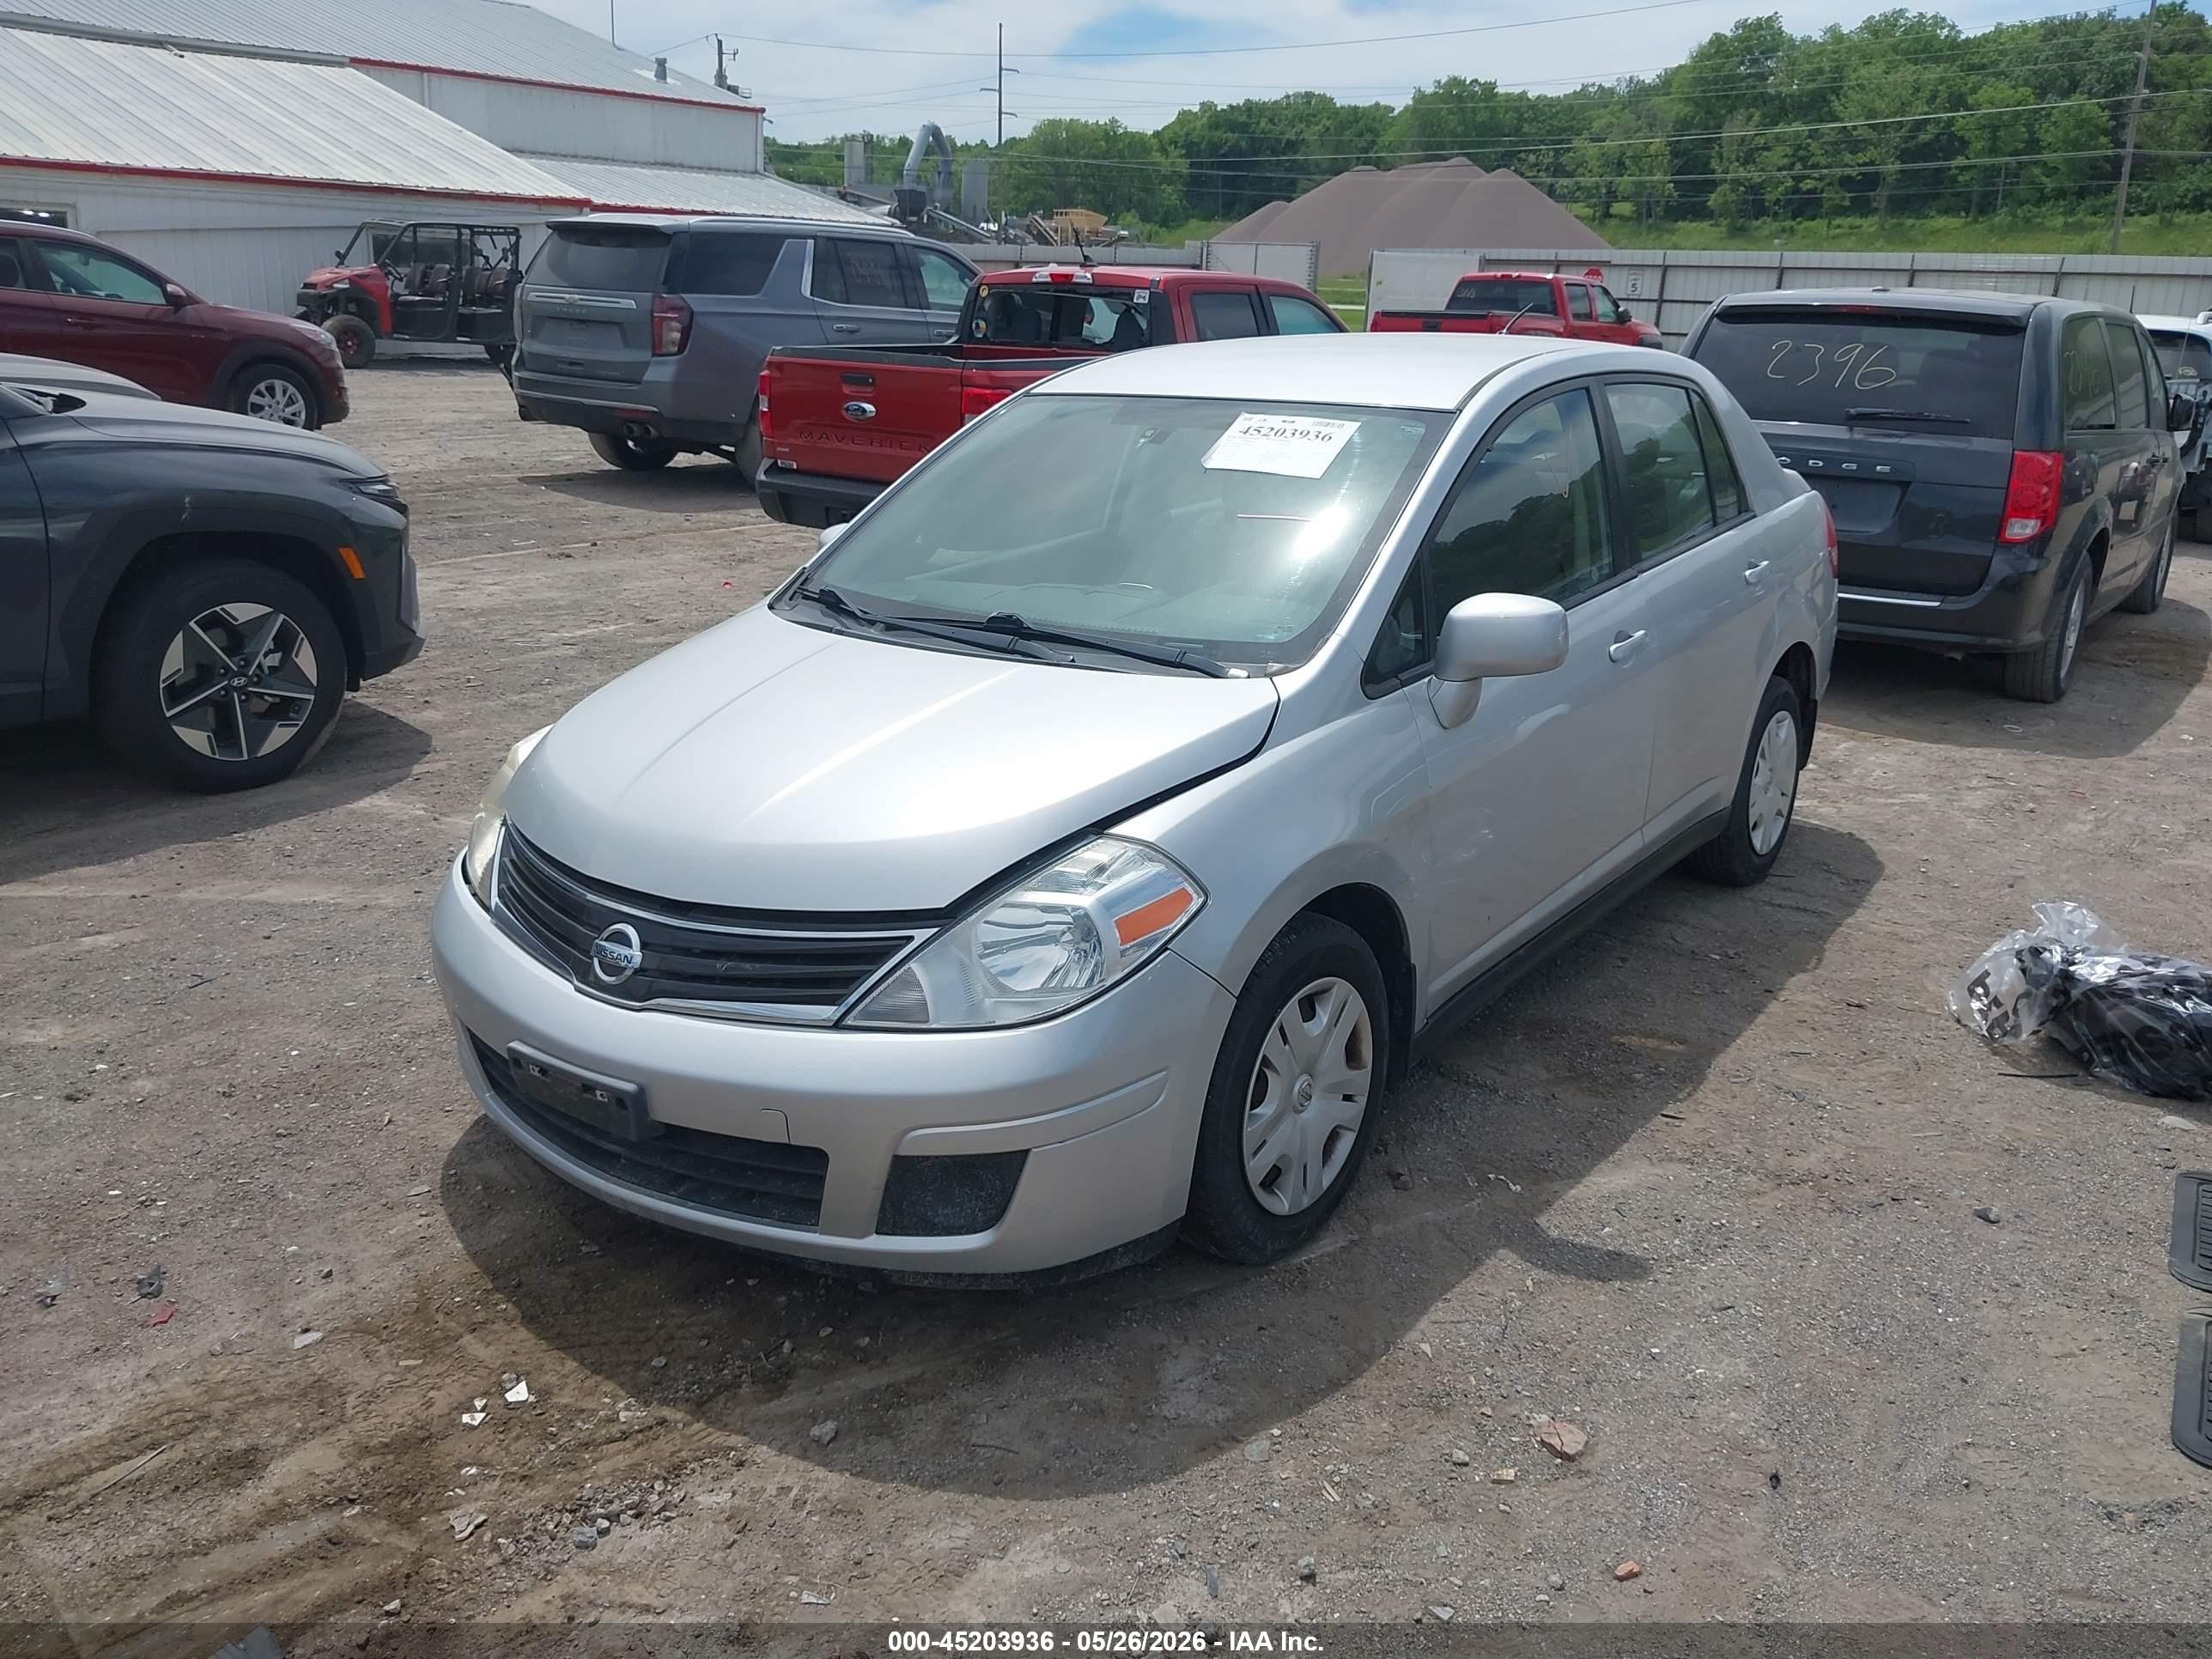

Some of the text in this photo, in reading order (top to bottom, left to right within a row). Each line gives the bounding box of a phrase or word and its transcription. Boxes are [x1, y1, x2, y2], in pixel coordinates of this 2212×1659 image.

[1630, 283, 1638, 293] 5
[1765, 339, 1898, 390] 2396
[1237, 424, 1334, 443] 45203936
[1776, 455, 1893, 473] ODGE
[594, 944, 634, 964] NISSAN
